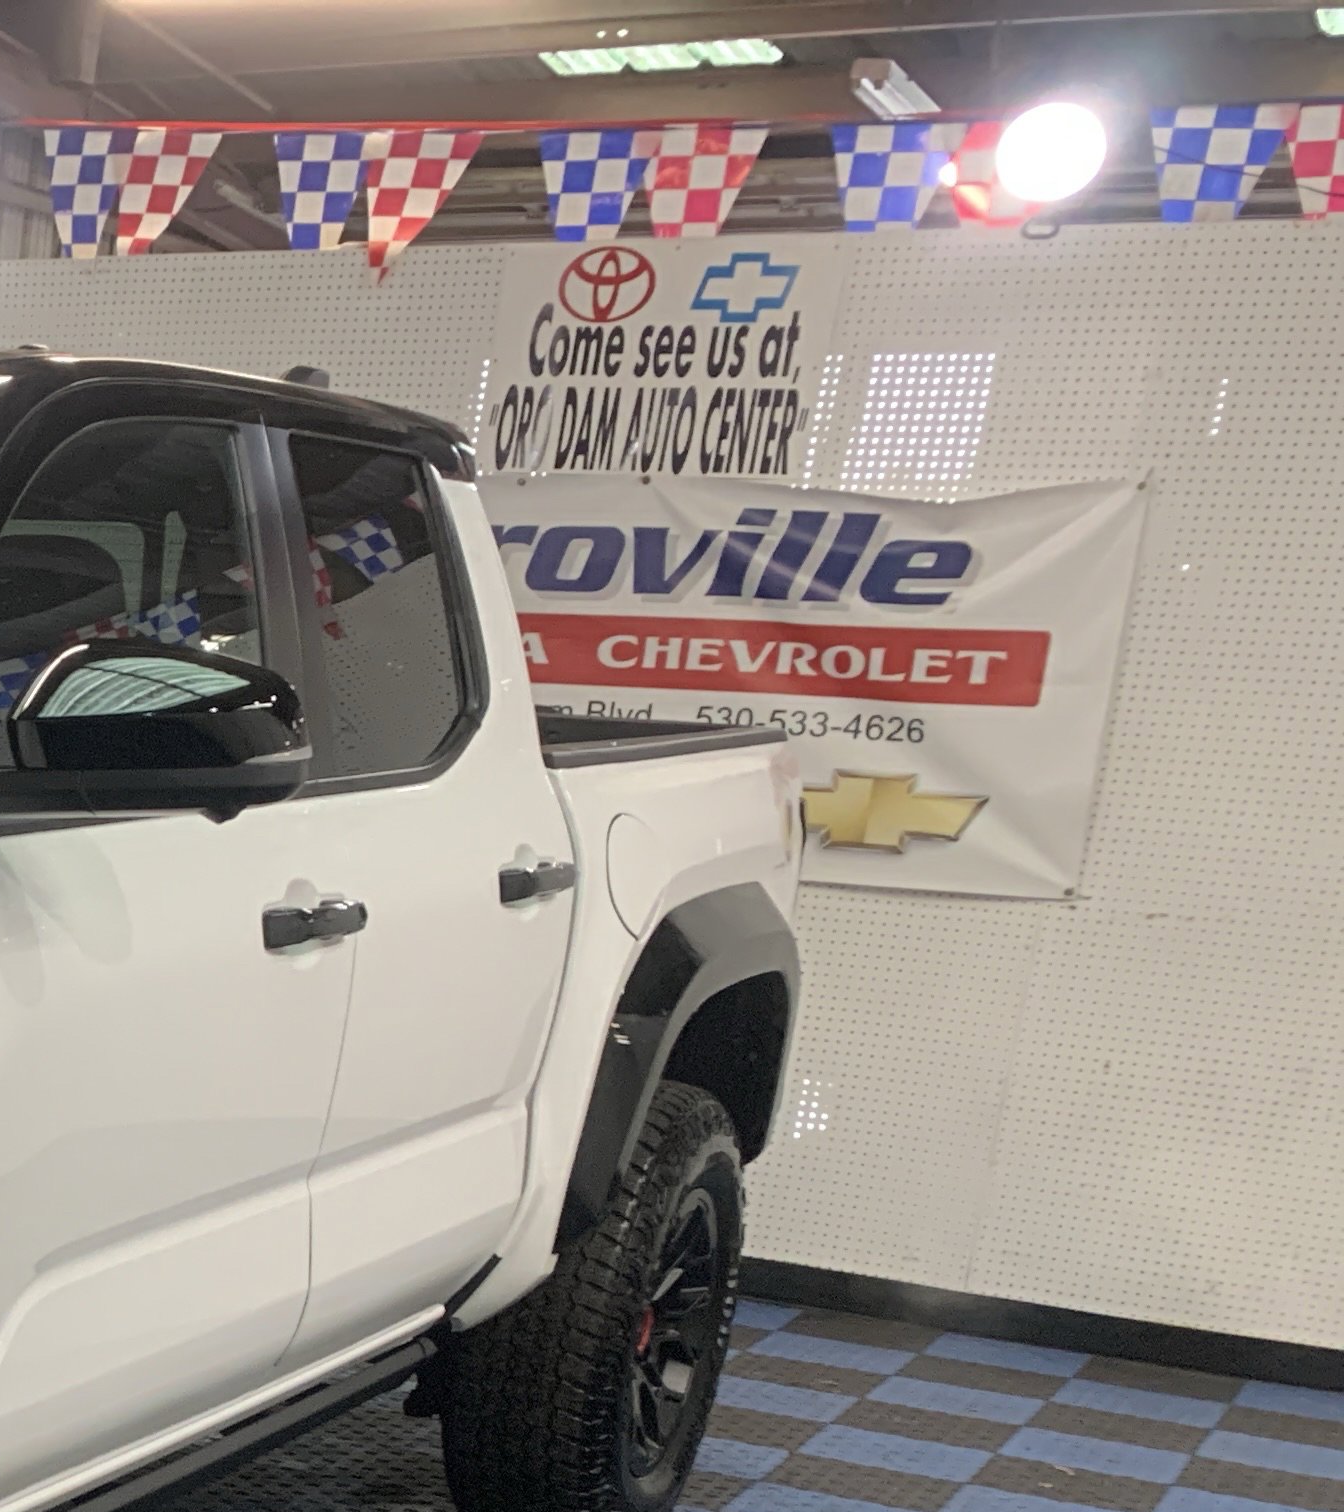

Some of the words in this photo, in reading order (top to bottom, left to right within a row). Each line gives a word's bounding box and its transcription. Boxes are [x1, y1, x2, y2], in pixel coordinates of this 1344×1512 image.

[528, 302, 626, 378] Come
[633, 324, 697, 378] see
[706, 324, 751, 378] us
[758, 309, 802, 384] at,
[554, 385, 623, 471] DAM
[619, 384, 698, 475] AUTO
[698, 386, 810, 476] CENTER"
[490, 507, 973, 606] roville
[596, 633, 1008, 685] CHEVROLET
[586, 701, 654, 720] Blvd
[697, 706, 925, 744] 530-533-4626
